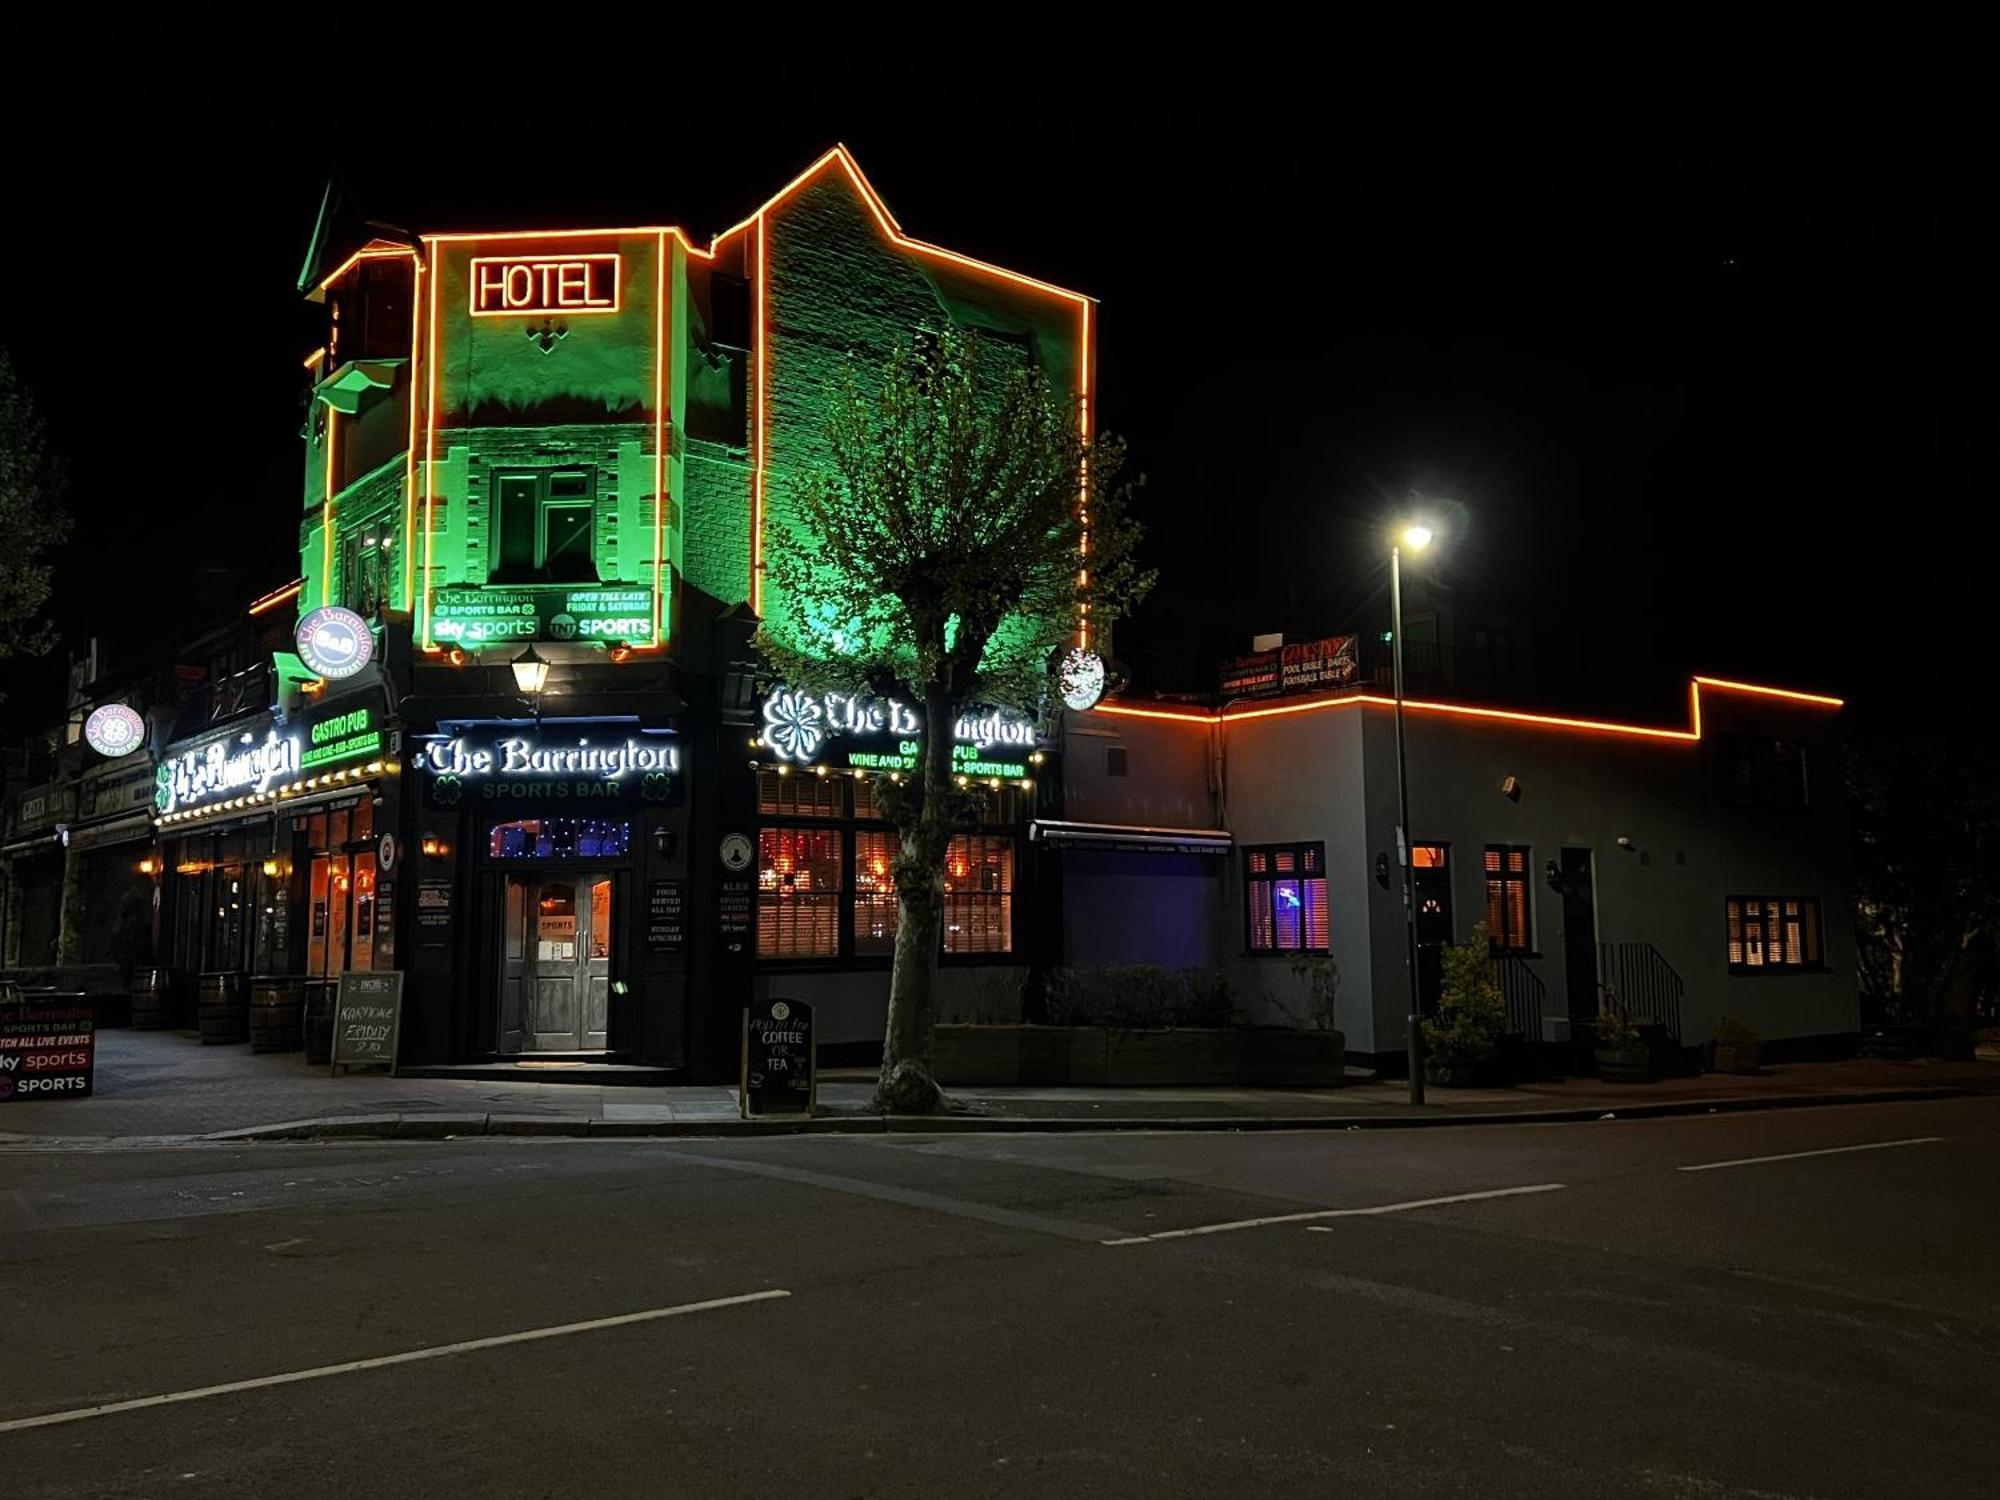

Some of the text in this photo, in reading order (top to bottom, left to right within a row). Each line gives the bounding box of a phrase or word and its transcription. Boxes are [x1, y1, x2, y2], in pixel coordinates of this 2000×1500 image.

[481, 263, 611, 308] HOTEL
[437, 591, 461, 604] The
[450, 605, 520, 615] SPORTS BAR
[567, 602, 597, 612] FRIDAY
[608, 601, 650, 611] SATURDAY
[301, 619, 321, 641] The
[434, 619, 536, 640] sky sports
[580, 618, 650, 635] SPORTS
[1283, 664, 1301, 675] POOL
[1302, 660, 1322, 671] TABLE
[1328, 656, 1351, 668] DARTS
[1283, 669, 1341, 687] FOOSBALL TABLE
[312, 709, 367, 743] GASTRO PUB
[425, 738, 679, 779] The Barrington
[953, 745, 978, 760] PUB
[848, 753, 878, 767] WINE
[878, 755, 902, 769] AND
[963, 762, 1003, 775] SPORTS
[1003, 764, 1025, 777] BAR
[482, 781, 620, 801] SPORTS BAR
[542, 920, 573, 931] SPORTS
[3, 1023, 77, 1034] SPORTS BAR
[0, 1034, 91, 1049] TCH ALL LIVE EVENTS
[762, 1031, 804, 1045] COFFEE
[0, 1052, 87, 1071] ky sports
[768, 1057, 788, 1072] TEA
[17, 1077, 86, 1093] SPORTS
